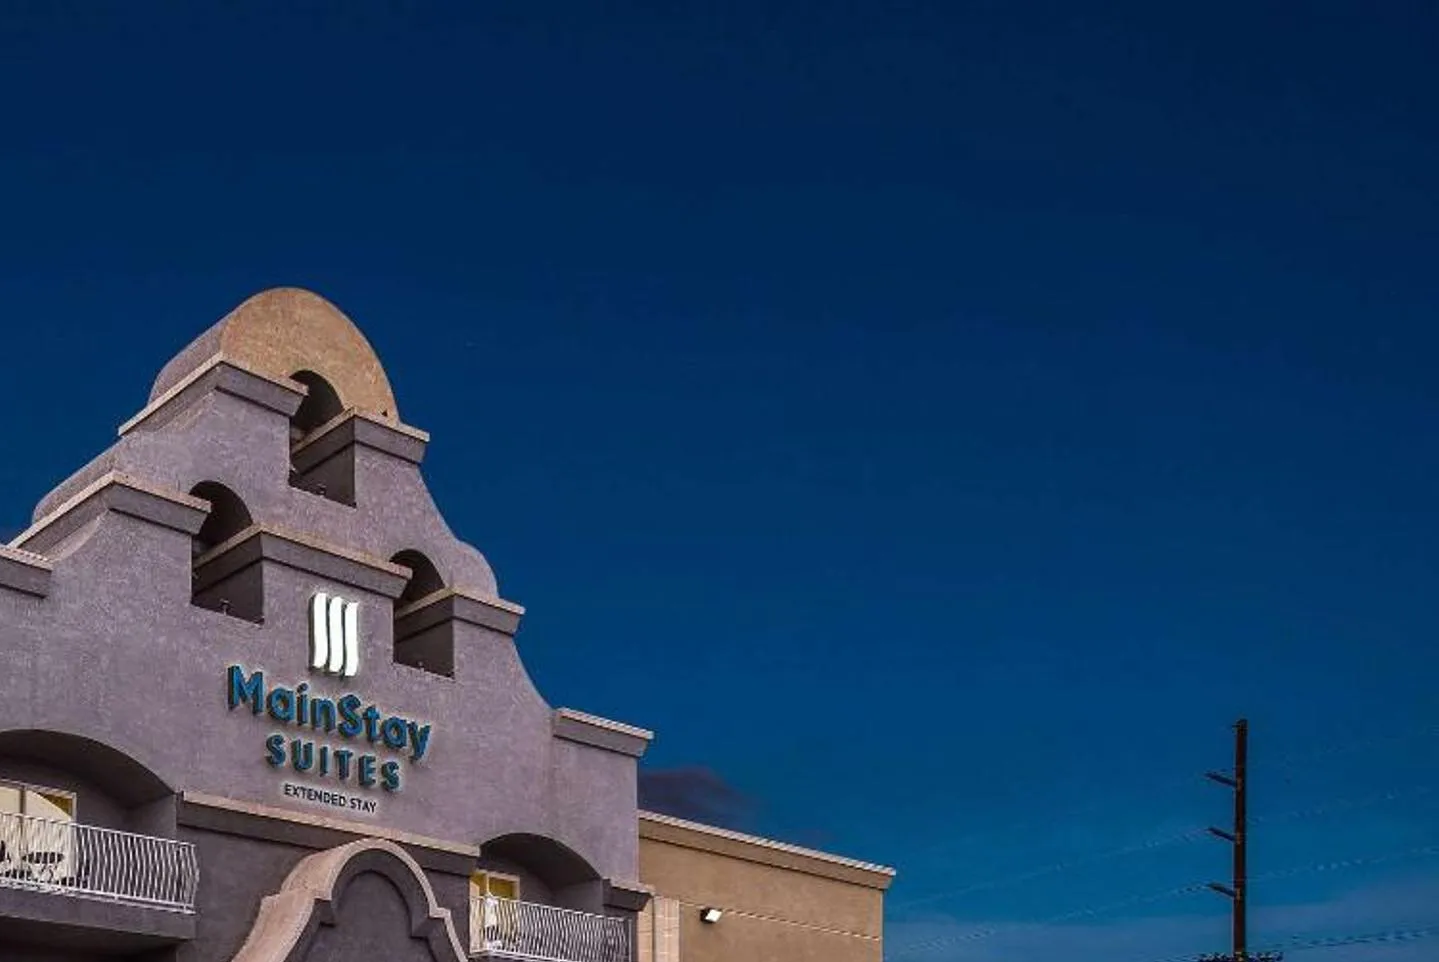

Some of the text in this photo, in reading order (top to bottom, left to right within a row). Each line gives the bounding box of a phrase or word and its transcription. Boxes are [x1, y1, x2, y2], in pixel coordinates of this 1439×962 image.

[228, 665, 431, 761] MainStay
[265, 734, 400, 790] SUITES
[284, 783, 377, 813] EXTENDED STAY
